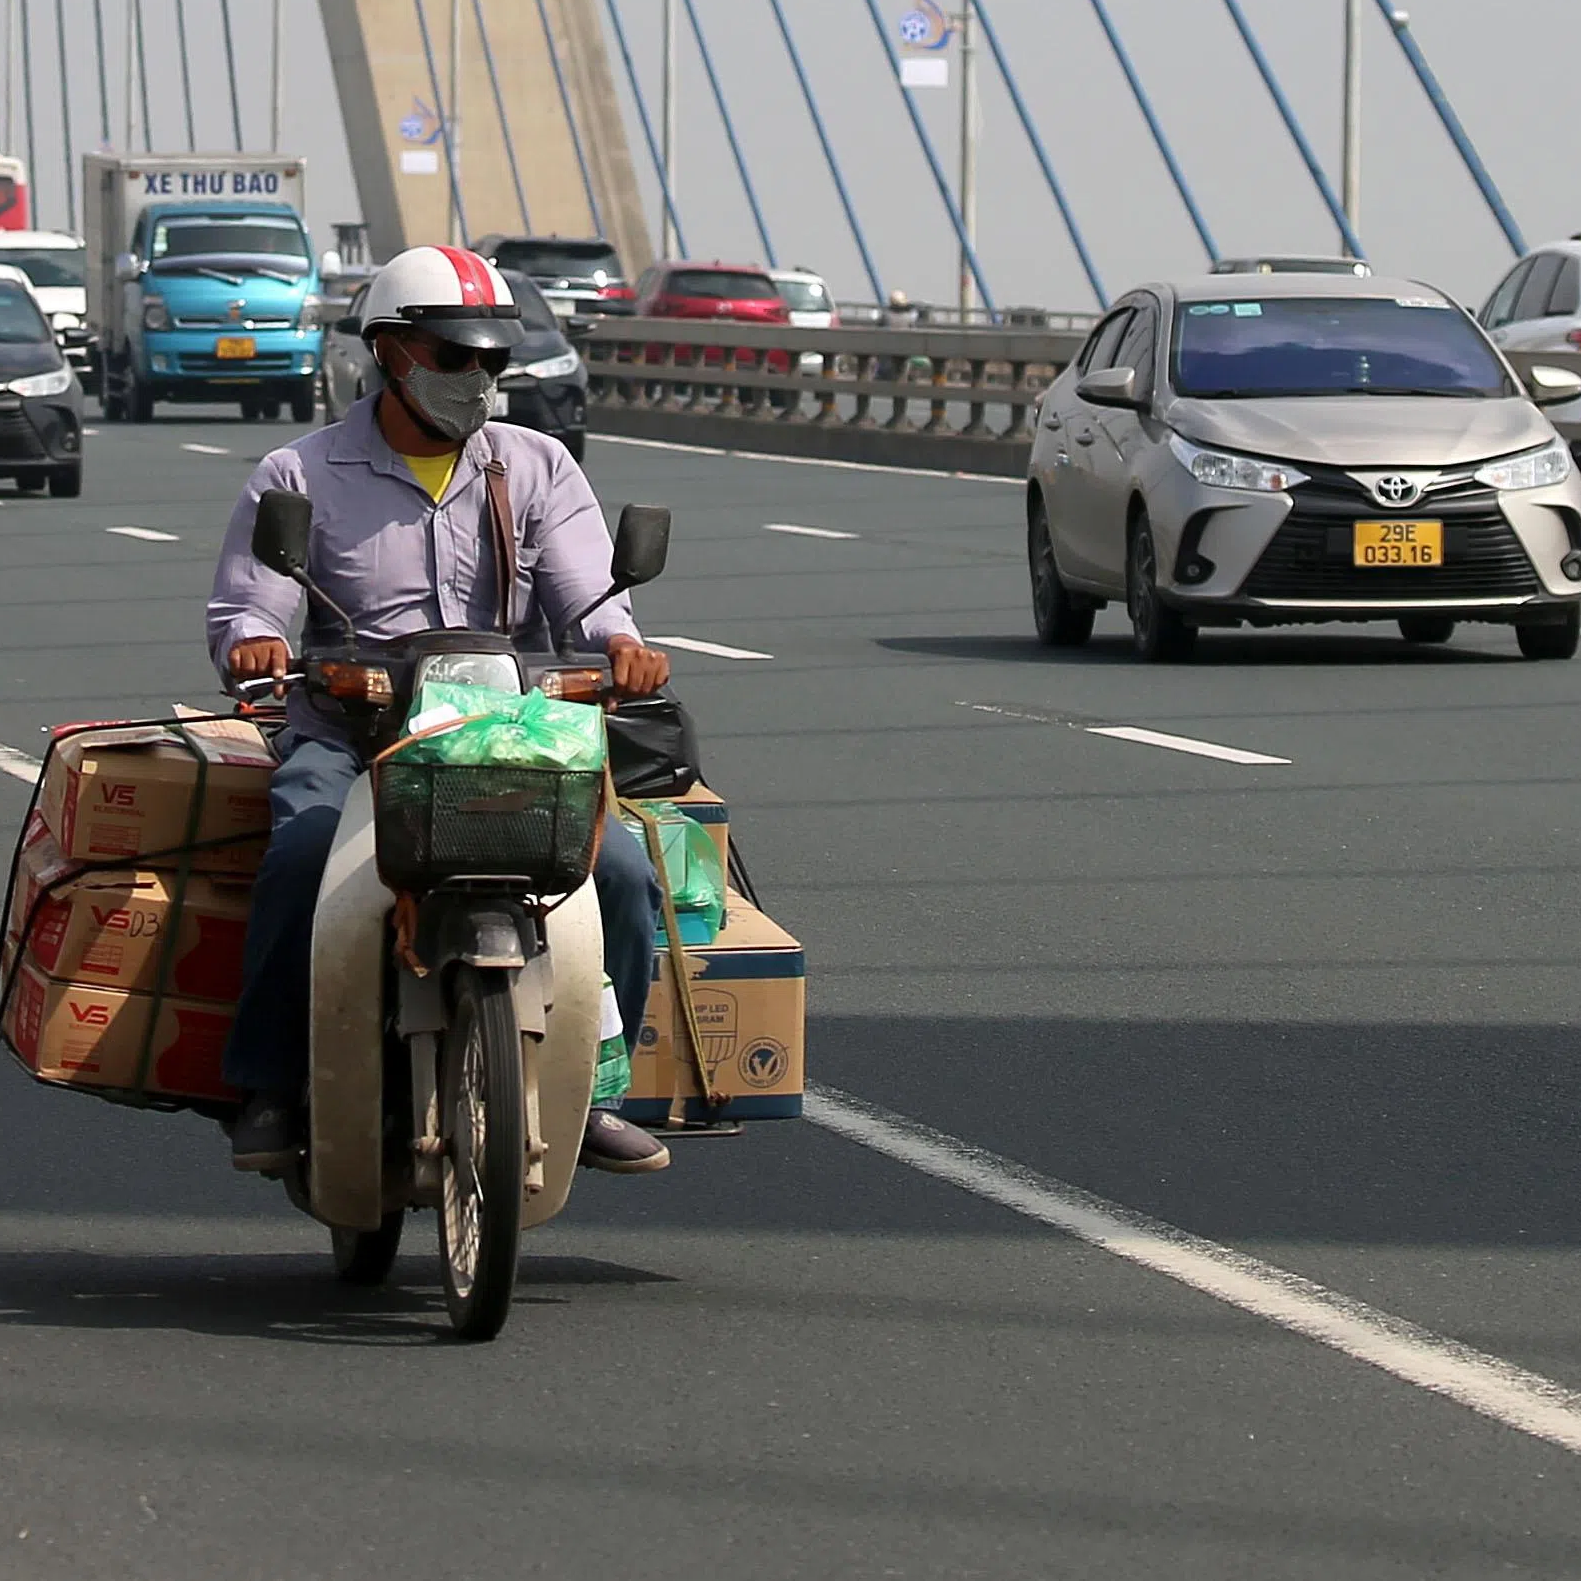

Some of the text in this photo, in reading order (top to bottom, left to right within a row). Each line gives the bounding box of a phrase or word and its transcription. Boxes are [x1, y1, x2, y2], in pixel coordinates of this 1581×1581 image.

[145, 173, 172, 194] XE
[1379, 524, 1417, 542] 29E
[1364, 546, 1432, 563] 033.16
[101, 783, 137, 806] VS
[90, 905, 132, 930] VS
[69, 1002, 109, 1025] VS
[709, 1004, 729, 1013] LED
